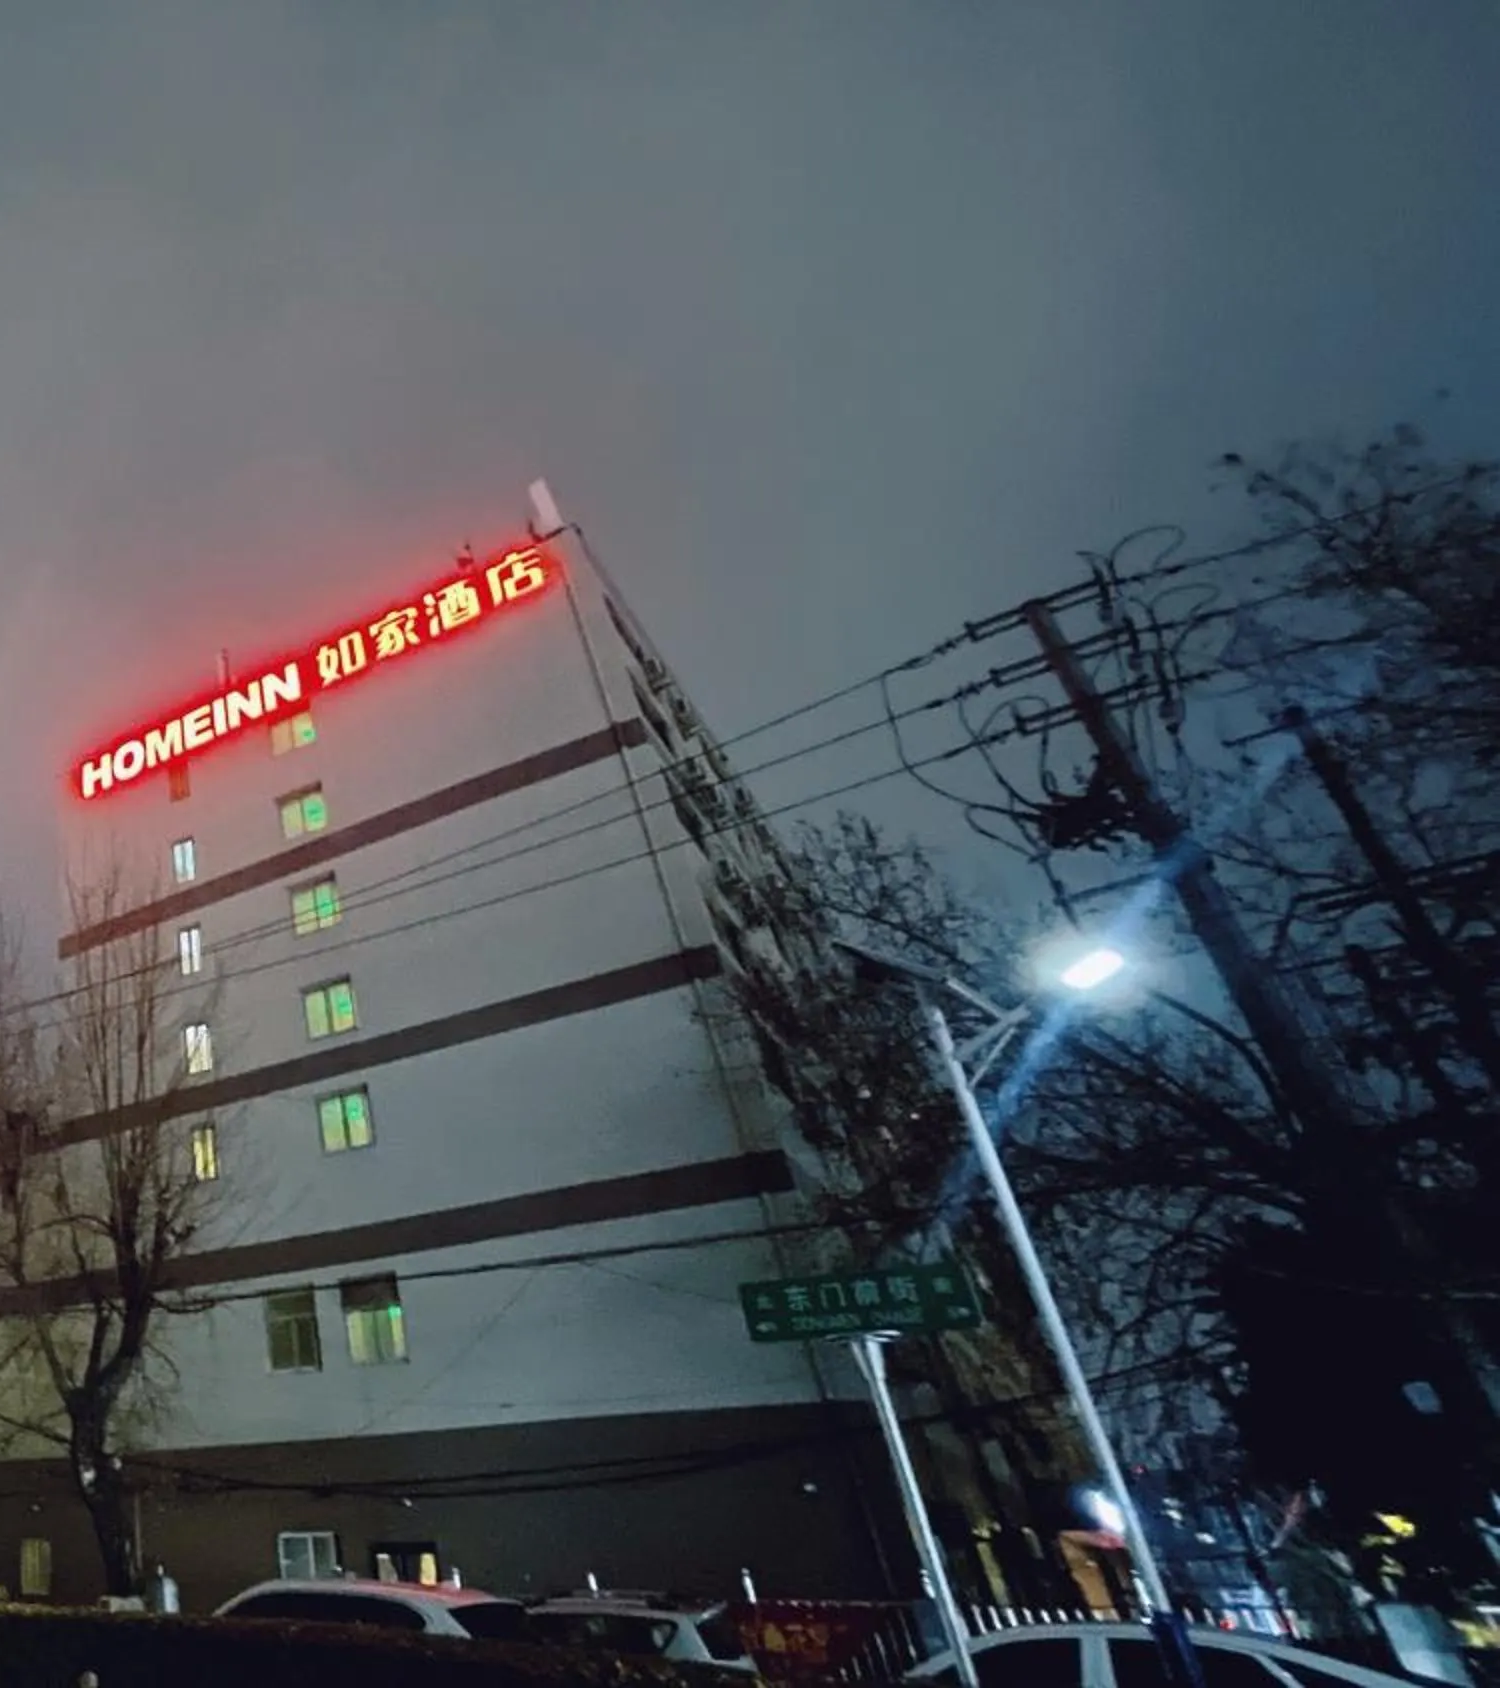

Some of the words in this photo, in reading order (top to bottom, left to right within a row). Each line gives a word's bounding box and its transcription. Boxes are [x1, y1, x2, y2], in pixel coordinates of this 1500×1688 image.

[315, 547, 546, 686] 如家酒店
[81, 662, 301, 799] HOMEINN
